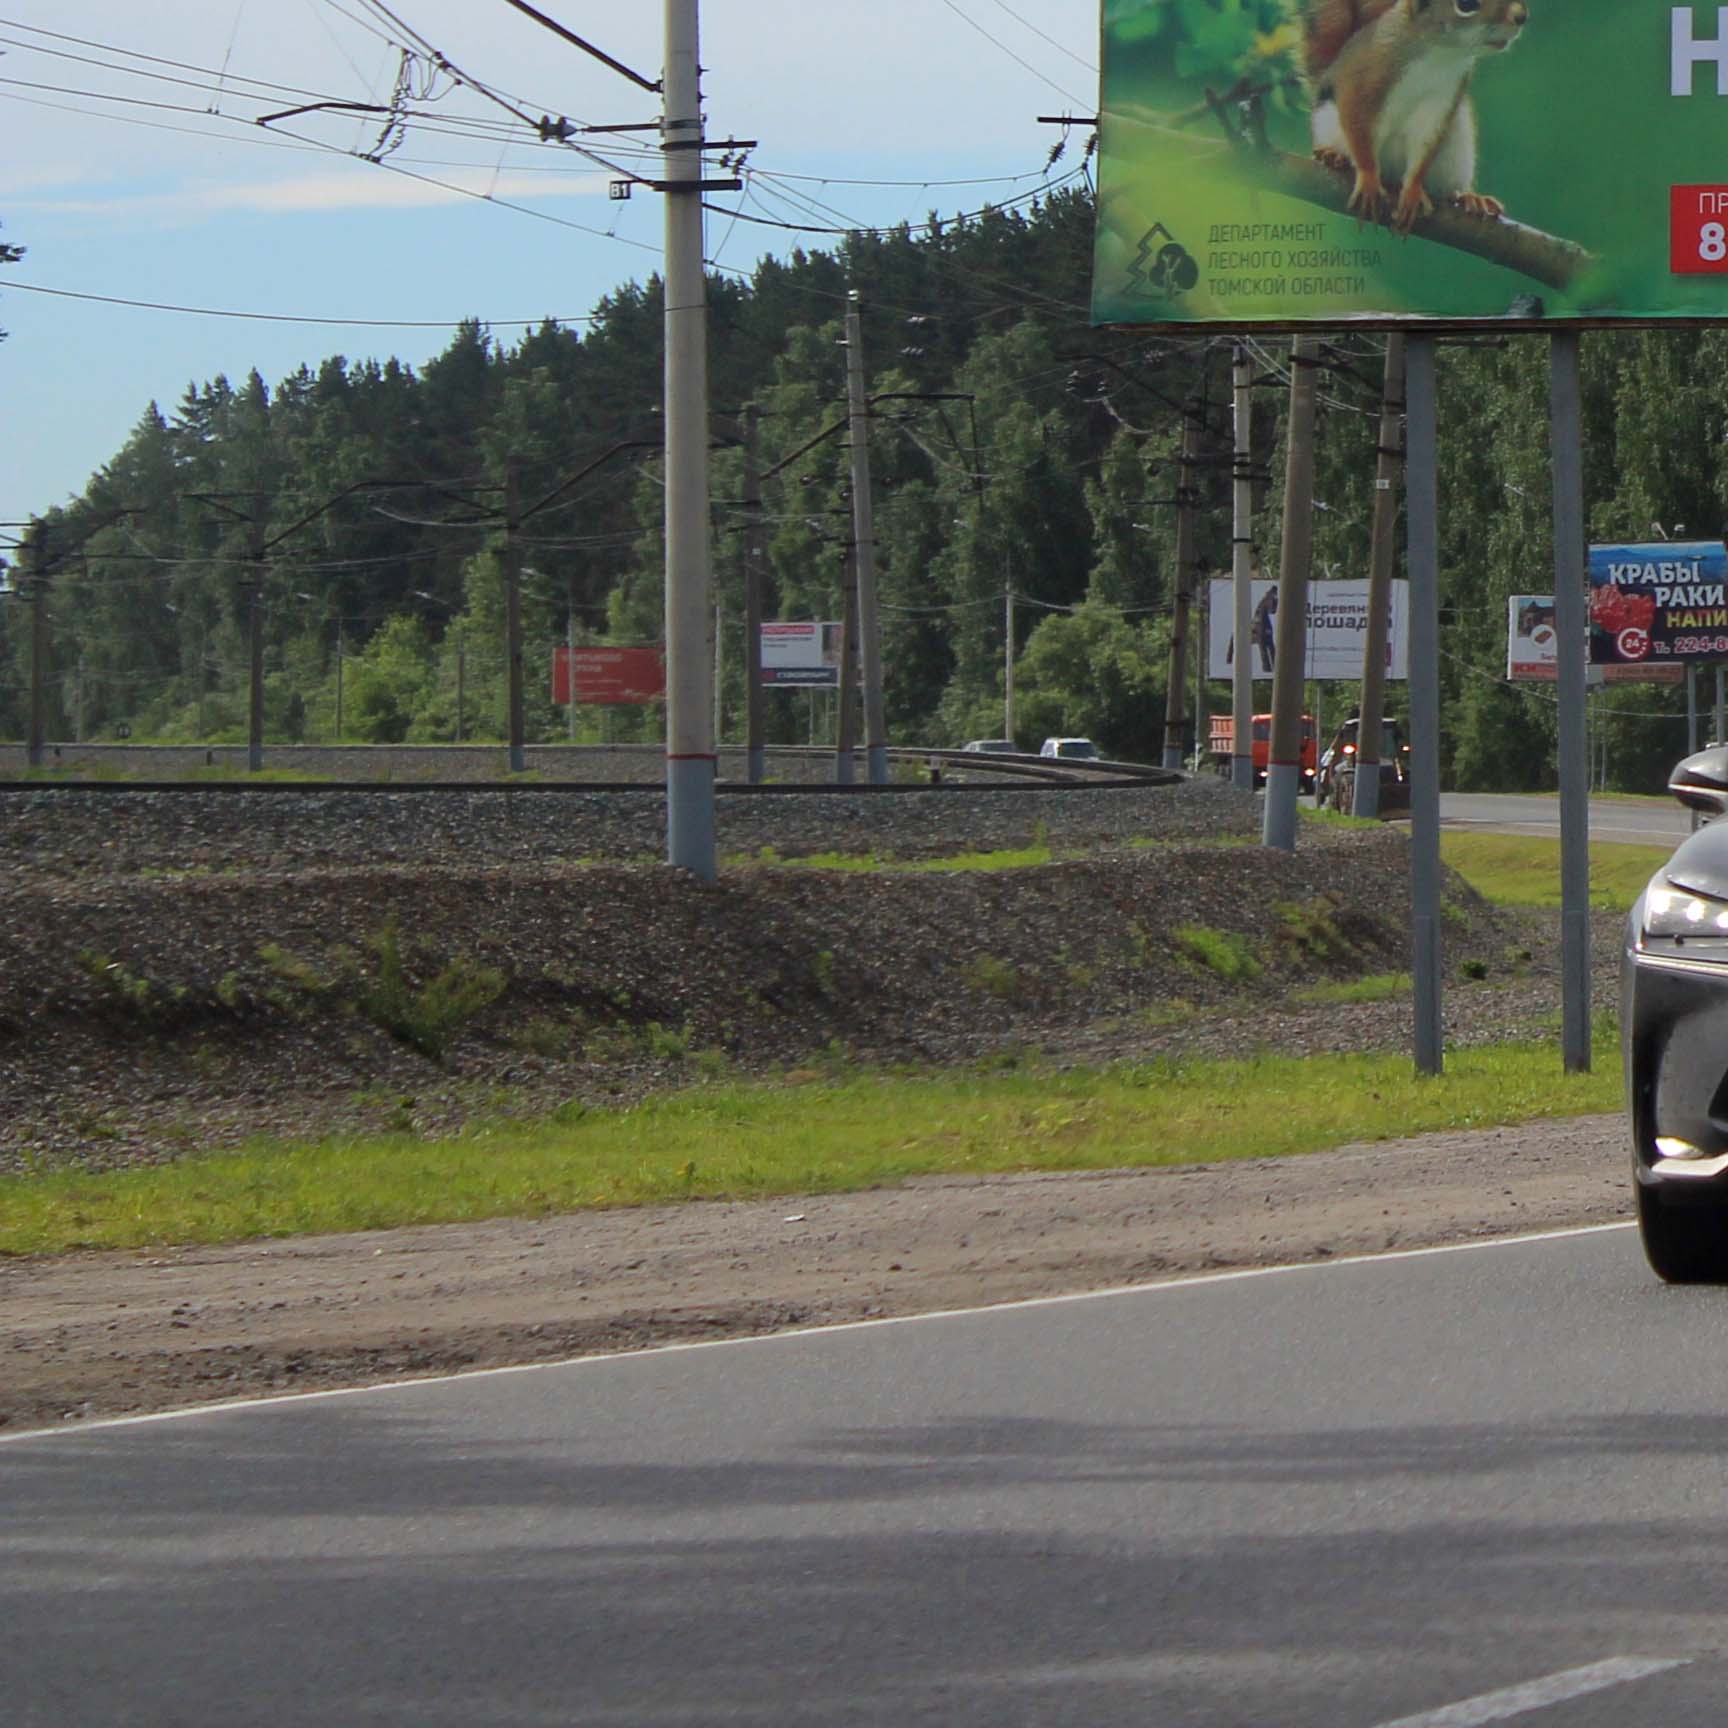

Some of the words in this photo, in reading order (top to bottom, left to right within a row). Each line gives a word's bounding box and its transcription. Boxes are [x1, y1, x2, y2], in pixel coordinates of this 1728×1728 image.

[1207, 223, 1326, 243] ДЕПАРТАМЕНТ
[1207, 251, 1281, 269] ЛЕСНОГО
[1287, 247, 1382, 268] ХОЗЯЙСТВА
[1208, 275, 1285, 296] ТОМСКОЙ
[1291, 277, 1365, 295] ОБЛАСТИ
[1608, 562, 1700, 585] КРАБЫ
[1655, 585, 1726, 608] РАКИ
[1625, 638, 1640, 649] 24
